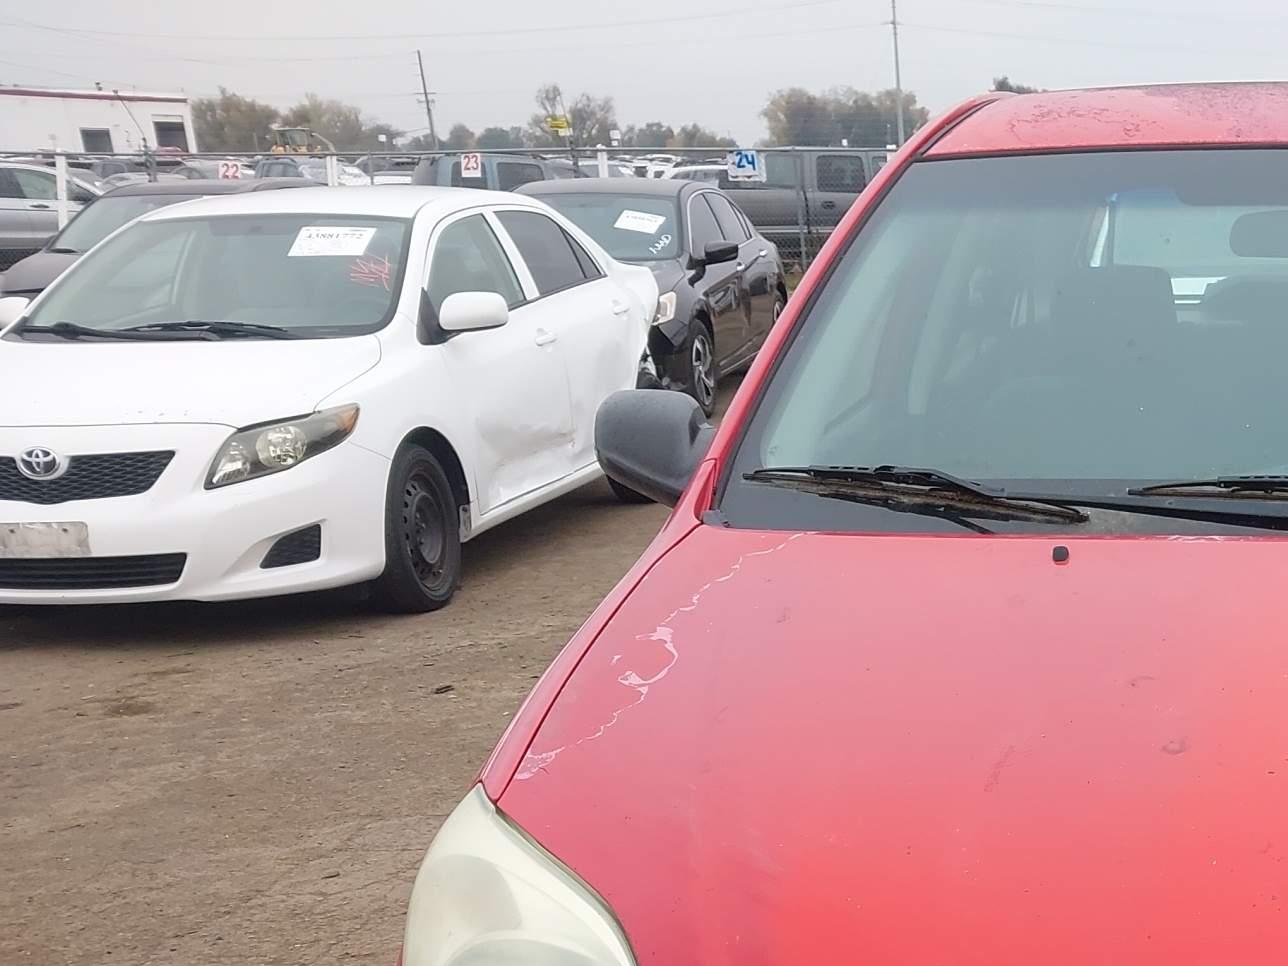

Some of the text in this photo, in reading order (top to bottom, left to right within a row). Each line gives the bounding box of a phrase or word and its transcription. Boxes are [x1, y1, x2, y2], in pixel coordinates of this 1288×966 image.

[463, 154, 479, 171] 23
[736, 151, 756, 171] 24
[222, 163, 239, 179] 22
